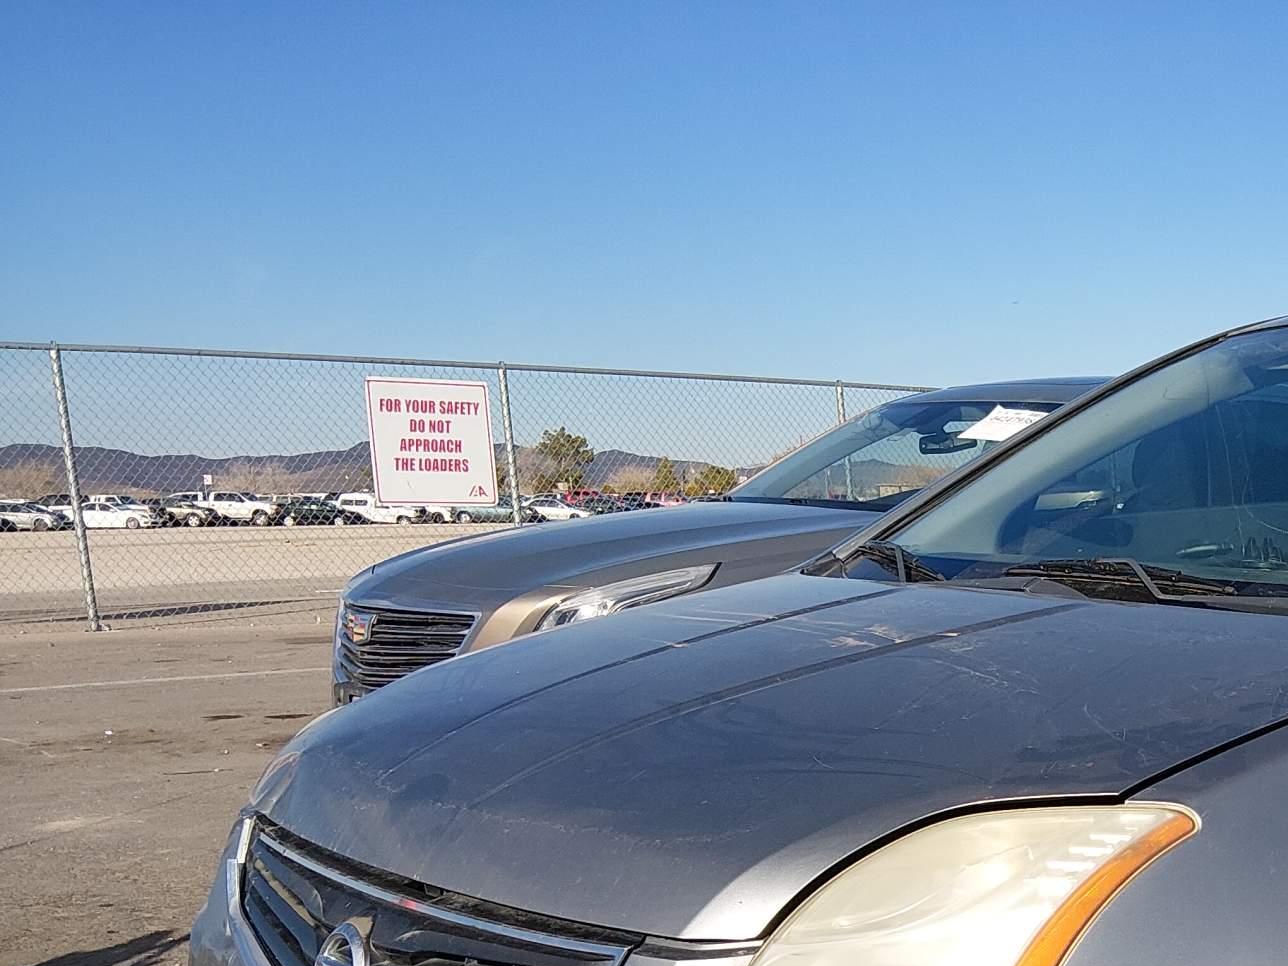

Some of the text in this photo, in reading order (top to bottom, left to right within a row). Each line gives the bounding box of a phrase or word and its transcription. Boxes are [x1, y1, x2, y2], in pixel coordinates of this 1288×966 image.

[379, 398, 479, 415] FOR YOUR SAFETY
[409, 419, 452, 434] DO NOT
[400, 438, 462, 453] APPROACH
[394, 457, 470, 473] THE LOADERS
